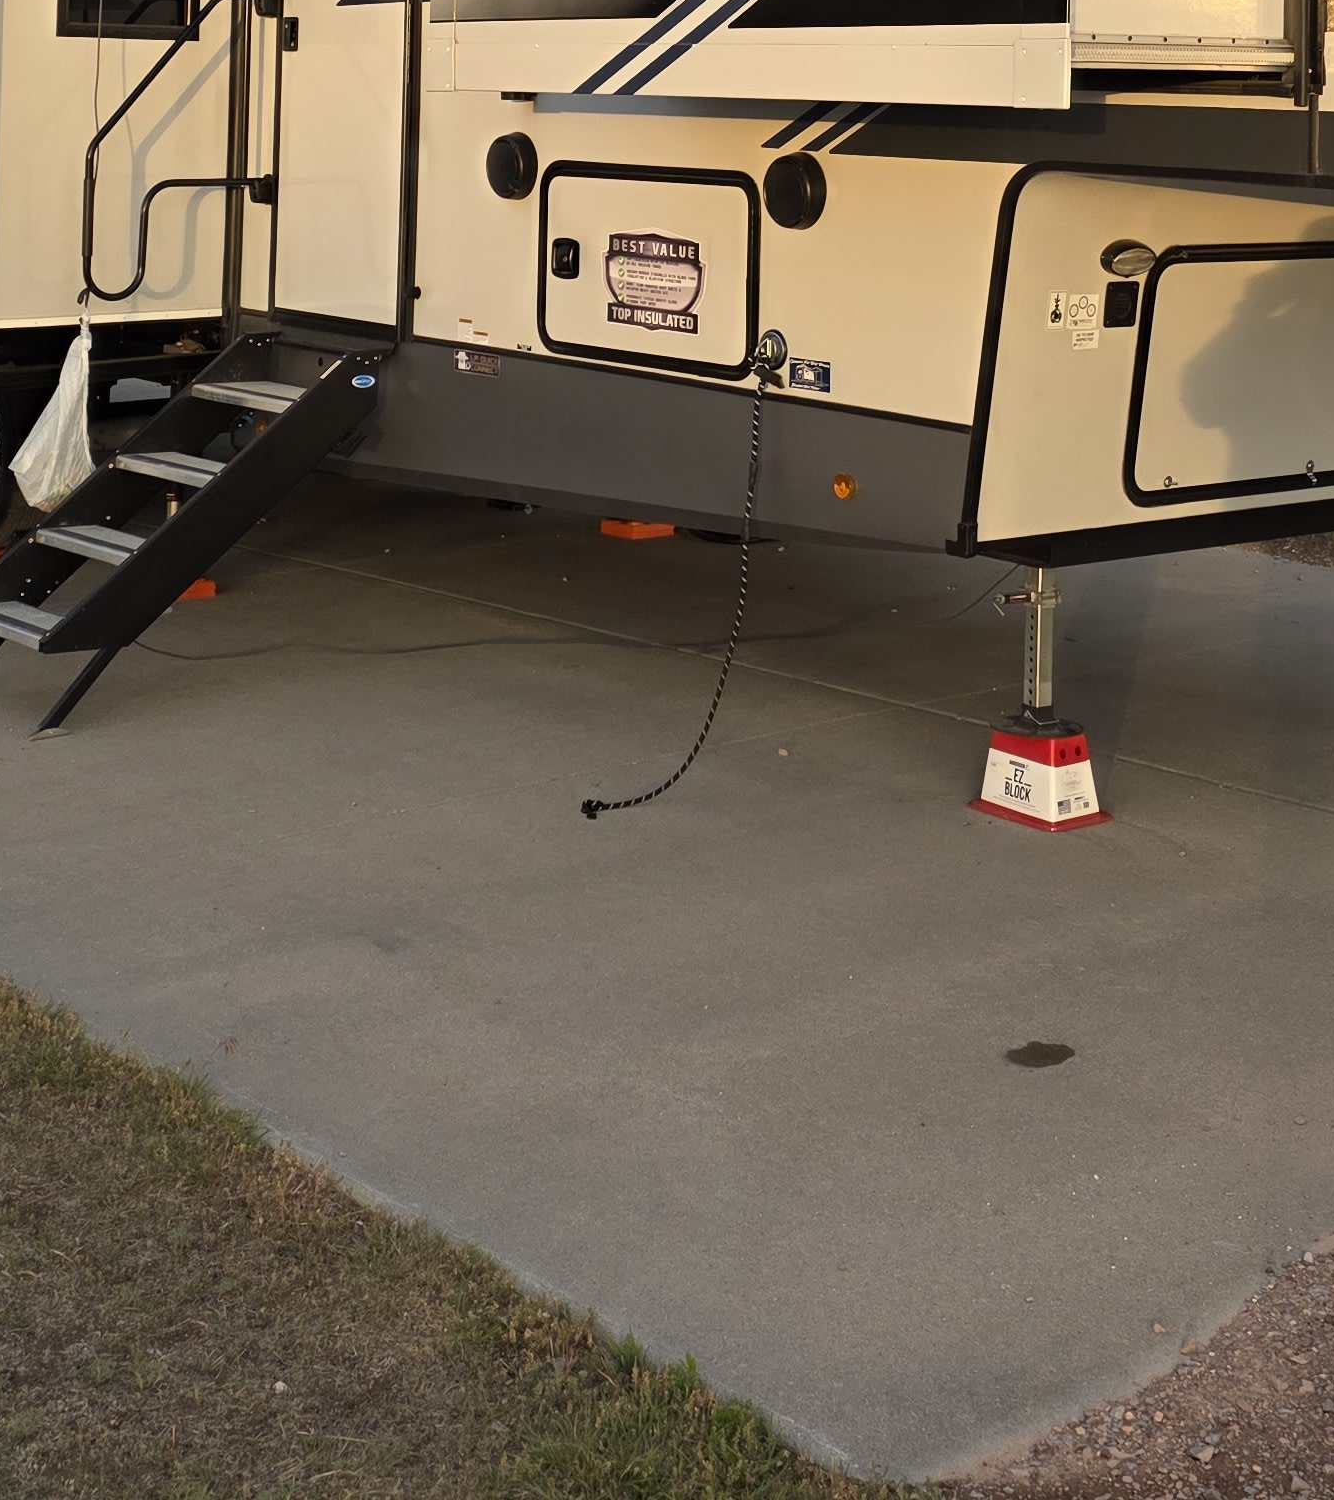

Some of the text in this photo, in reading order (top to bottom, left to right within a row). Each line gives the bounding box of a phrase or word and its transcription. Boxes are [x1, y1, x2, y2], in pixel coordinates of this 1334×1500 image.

[612, 238, 696, 260] BEST VALUE
[611, 306, 694, 330] TOP INSULATED
[1014, 768, 1024, 784] EZ
[1004, 781, 1032, 803] BLOCK
